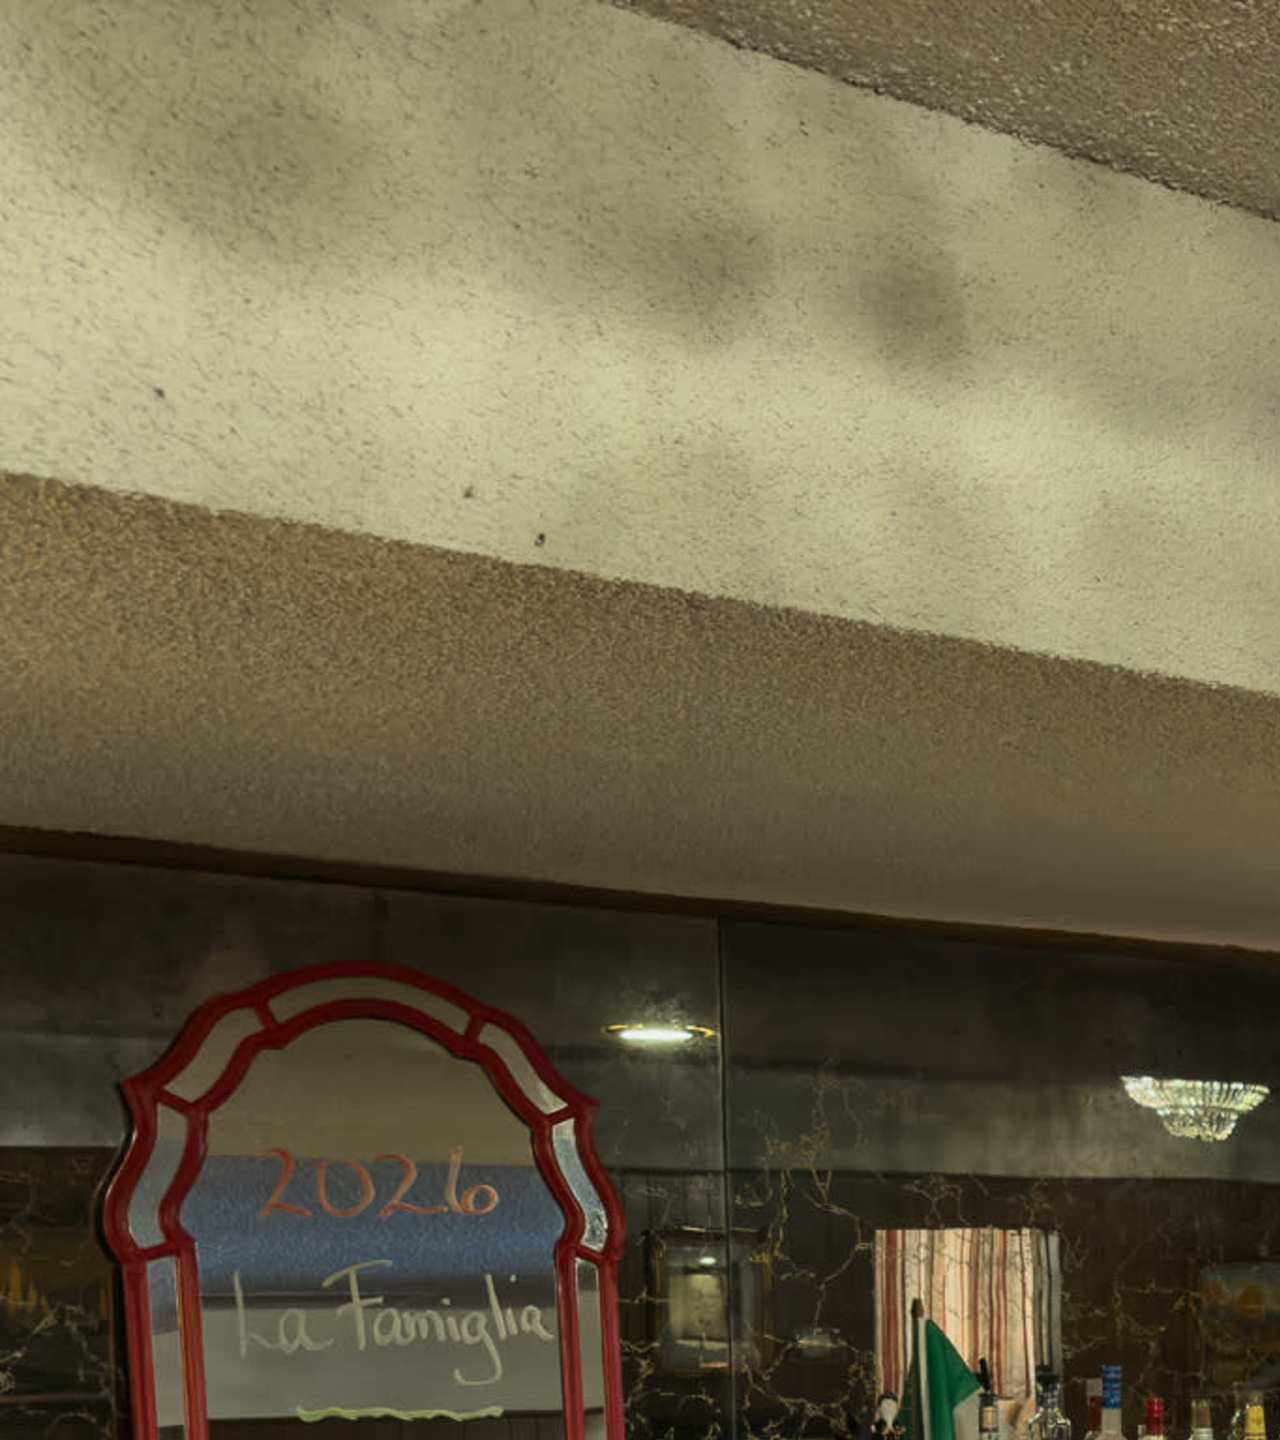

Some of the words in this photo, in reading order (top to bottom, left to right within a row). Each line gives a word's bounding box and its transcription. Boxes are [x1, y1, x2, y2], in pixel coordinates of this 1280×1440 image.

[256, 1146, 499, 1222] 2026
[233, 1270, 335, 1359] La
[321, 1259, 555, 1385] Famiglia
